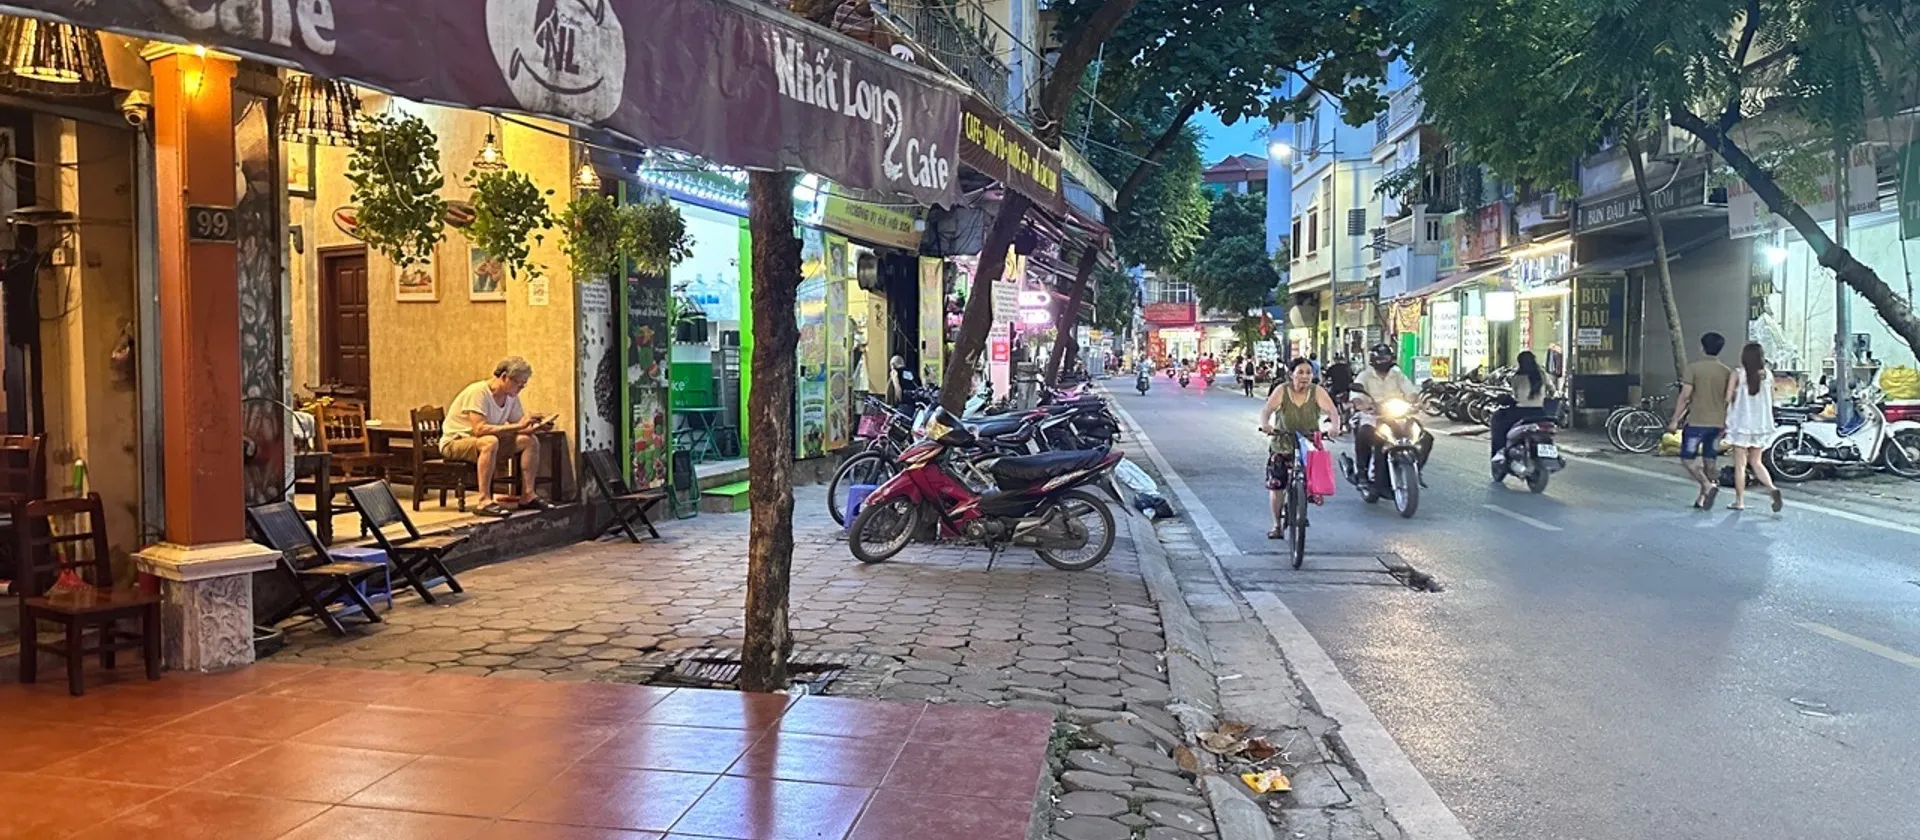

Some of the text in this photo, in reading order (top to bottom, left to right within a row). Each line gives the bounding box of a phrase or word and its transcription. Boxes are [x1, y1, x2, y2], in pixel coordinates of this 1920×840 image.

[543, 20, 580, 75] NL
[773, 31, 839, 112] Nhất
[906, 137, 949, 190] Cafe
[197, 211, 229, 237] 99
[1580, 283, 1611, 305] BÚN
